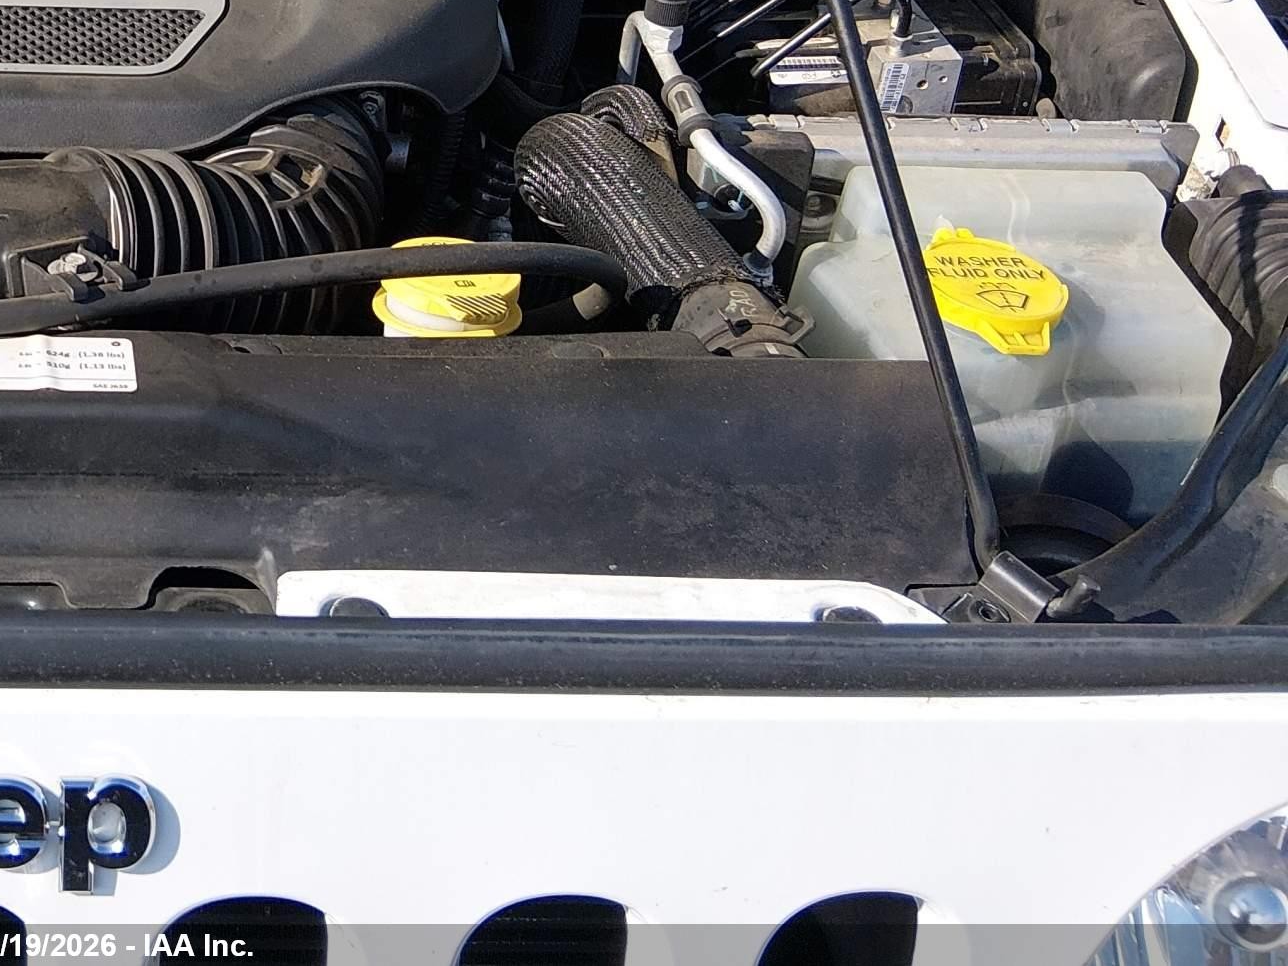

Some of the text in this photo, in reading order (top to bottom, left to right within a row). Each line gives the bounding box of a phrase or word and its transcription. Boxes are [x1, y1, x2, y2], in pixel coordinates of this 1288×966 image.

[934, 255, 1027, 268] WASHER
[927, 267, 1046, 282] FLUID ONLY
